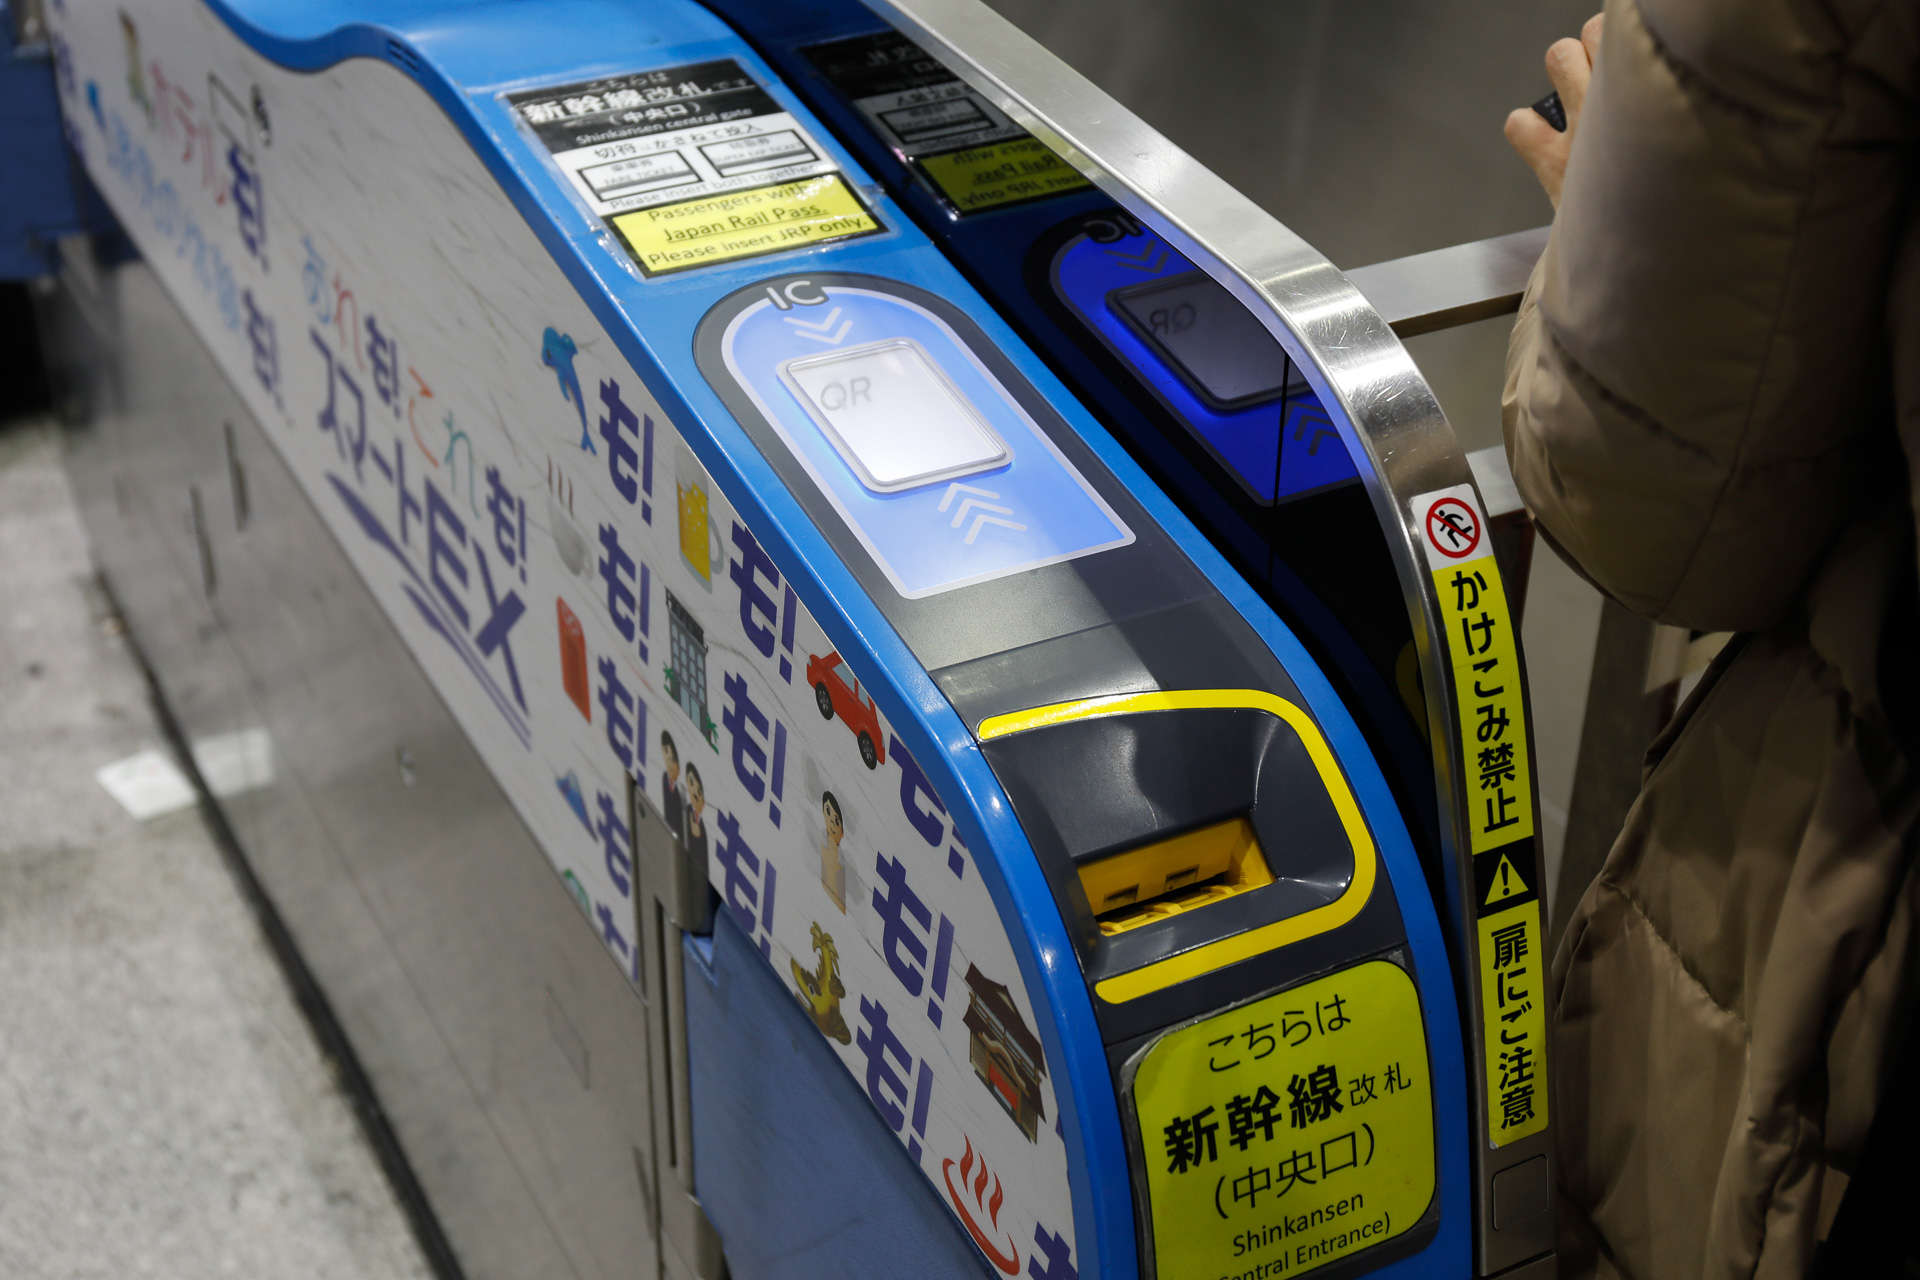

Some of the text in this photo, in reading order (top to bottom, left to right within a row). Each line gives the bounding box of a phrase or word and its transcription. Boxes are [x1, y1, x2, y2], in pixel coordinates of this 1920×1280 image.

[575, 107, 754, 145] Shinkansen central gate
[604, 165, 676, 187] FARE TICKET
[610, 194, 652, 210] Please
[664, 184, 708, 200] insert
[711, 177, 741, 191] both
[648, 182, 809, 222] Passengers with
[649, 215, 868, 266] Please insert JRP only.
[666, 204, 829, 242] Japan Rail Pass.
[766, 280, 825, 309] IC
[820, 375, 874, 412] QR
[599, 377, 654, 527] も!
[309, 326, 529, 718] スマートEX
[599, 522, 650, 667] も!
[730, 519, 798, 686] も!
[597, 655, 648, 792] も!
[723, 670, 788, 831] も!
[1451, 569, 1519, 834] かけこみ禁止
[715, 808, 777, 962] も!
[872, 851, 955, 1031] も!
[856, 993, 934, 1166] も!
[1208, 994, 1352, 1074] こちらは
[1491, 920, 1536, 1131] 扉にご注意
[1163, 1063, 1412, 1175] 新幹線改札
[1233, 1193, 1364, 1257] Shinkansen
[1296, 1211, 1391, 1266] Entrance)
